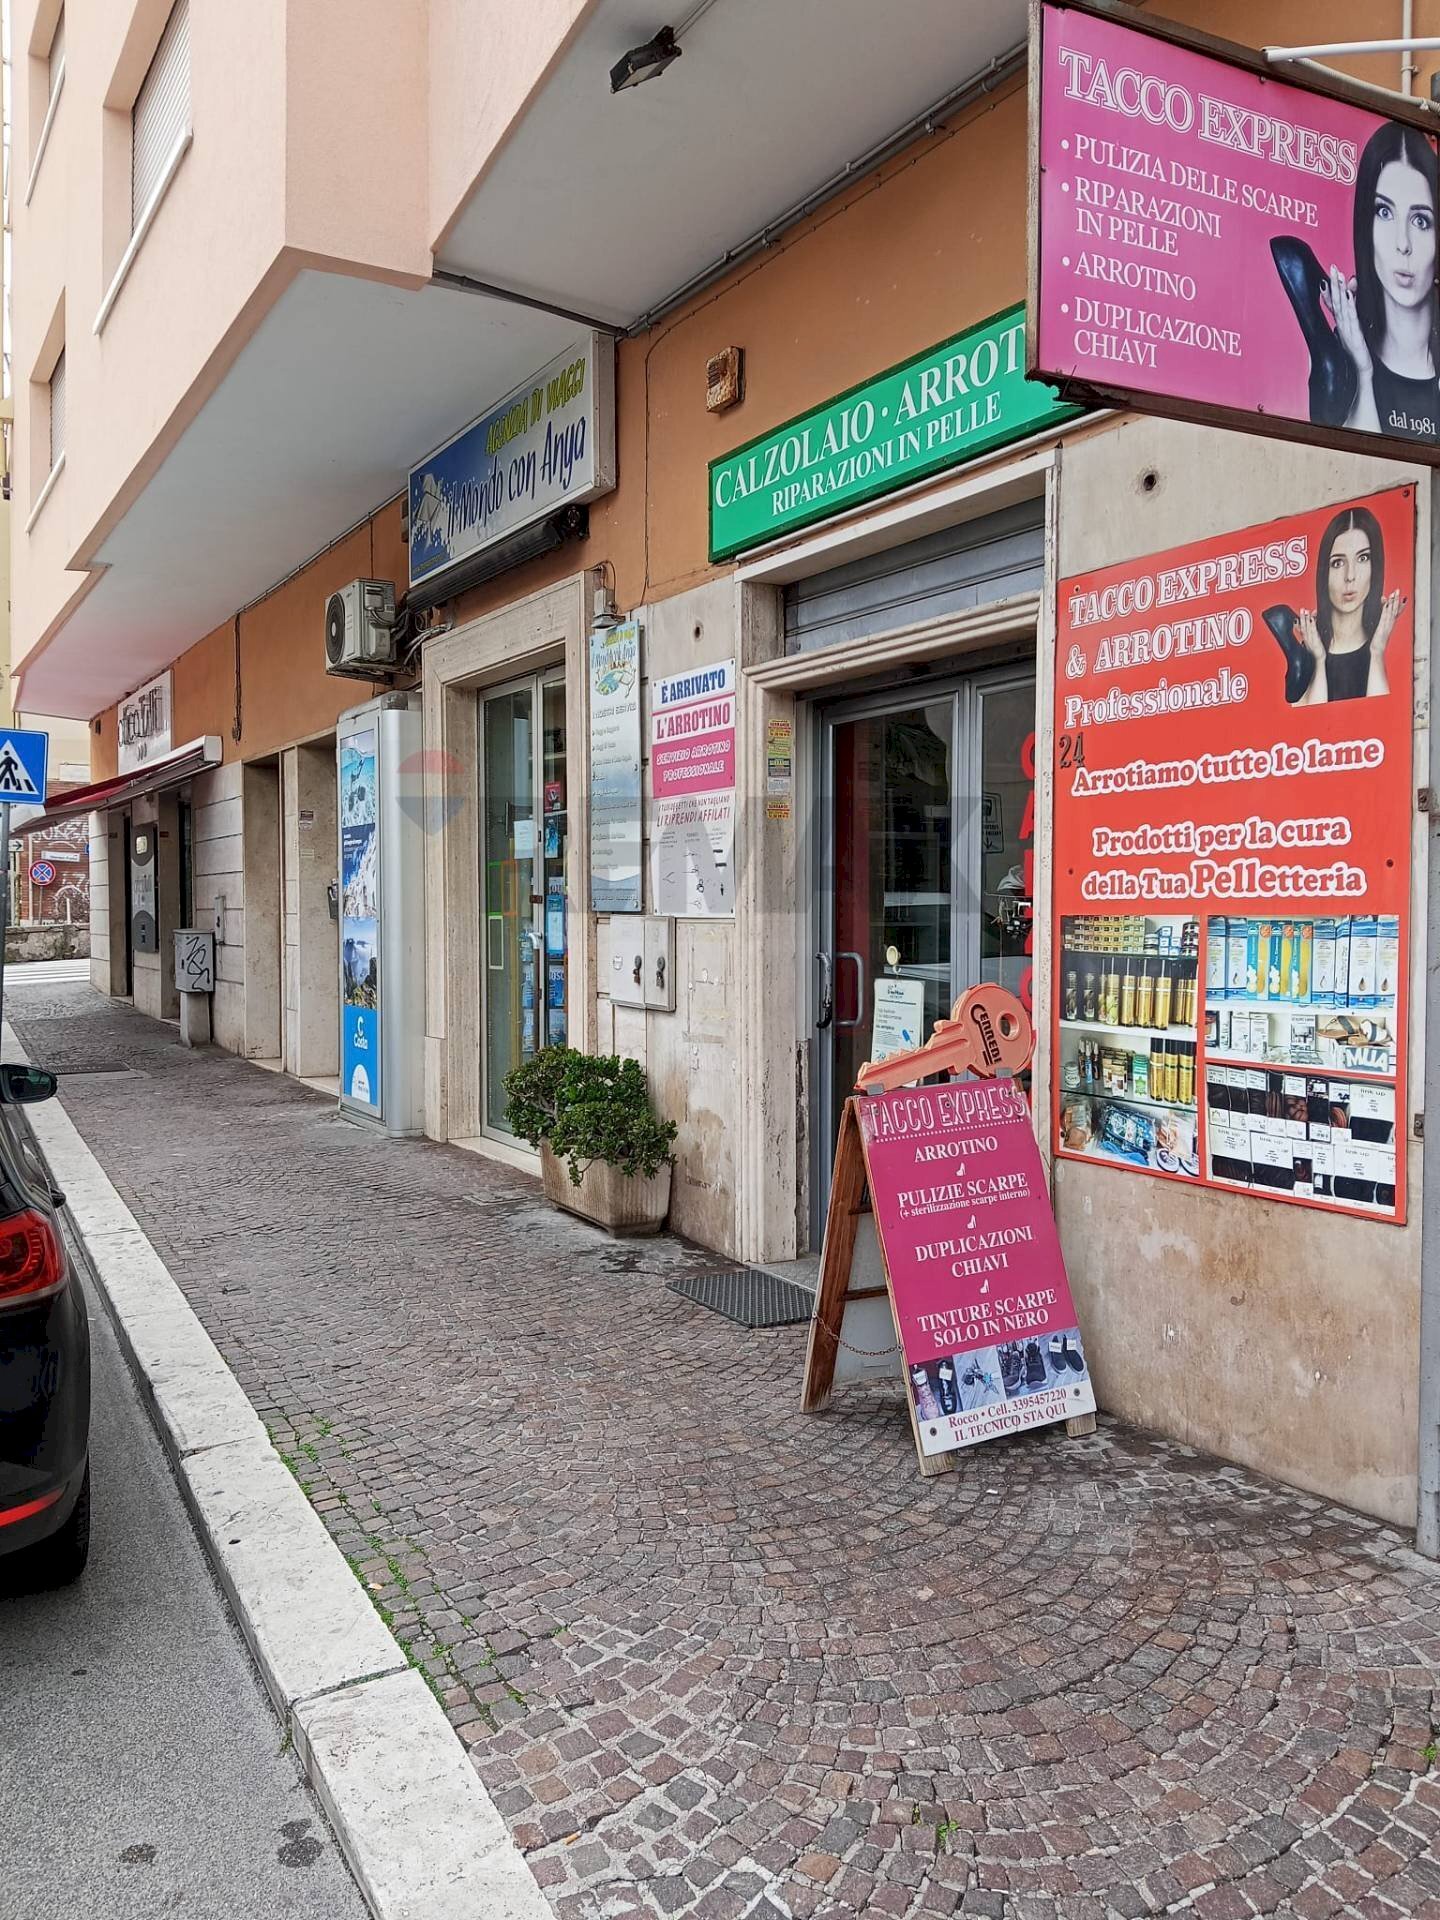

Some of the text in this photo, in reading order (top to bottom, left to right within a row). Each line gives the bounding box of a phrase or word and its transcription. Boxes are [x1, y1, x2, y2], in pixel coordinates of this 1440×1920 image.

[1059, 46, 1357, 185] TACCO EXPRESS
[1075, 134, 1319, 227] PULIZIA DELLE SCARPE
[1076, 176, 1221, 238] RIPARAZIONI
[1077, 208, 1178, 256] IN PELLE
[1074, 250, 1196, 301] ARROTINO
[1074, 297, 1242, 357] DUPLICAZIONE
[1074, 330, 1157, 368] CHIAVI
[530, 388, 543, 426] DI
[547, 358, 585, 414] VIAGGI
[1389, 410, 1437, 435] dal 1981
[715, 400, 875, 508] CALZOLAIO
[772, 390, 1001, 516] RIPARAZIONI IN PELLE
[459, 454, 504, 535] Mondo
[508, 449, 536, 502] con
[540, 416, 586, 490] Anya
[1068, 535, 1308, 630] TACCO EXPRESS
[1065, 606, 1253, 679] & ARROTINO
[670, 668, 726, 702] ARRIVATO
[1064, 667, 1248, 728] Professionale
[657, 702, 730, 739] L'ARROTINO
[656, 740, 730, 765] SERVIZIO ARROTINO
[663, 760, 724, 782] PROFESSIONALE
[1059, 732, 1085, 769] 24
[1071, 738, 1384, 796] Arrotiamo tutte le lame
[664, 810, 698, 826] RIPRENDI
[699, 807, 731, 822] AFFILATI
[1092, 816, 1352, 857] Prodotti per la cura
[1081, 857, 1367, 900] della Tua Pelletteria
[865, 1085, 1026, 1137] TACCO EXPRESS
[914, 1135, 998, 1163] ARROTINO
[897, 1173, 1028, 1208] PULIZIE SCARPE
[911, 1198, 970, 1216] sterilizzazione
[971, 1193, 998, 1208] scarpe
[1000, 1188, 1031, 1202] interno)
[914, 1225, 1033, 1262] DUPLICAZIONI
[951, 1253, 1009, 1278] CHIAVI
[917, 1288, 1057, 1333] TINTURE SCARPE
[933, 1308, 1049, 1348] SOLO IN NERO
[948, 1388, 1067, 1428] Rocco Cell. 3395457220
[955, 1403, 1067, 1442] IL TECNICO STA QUI
